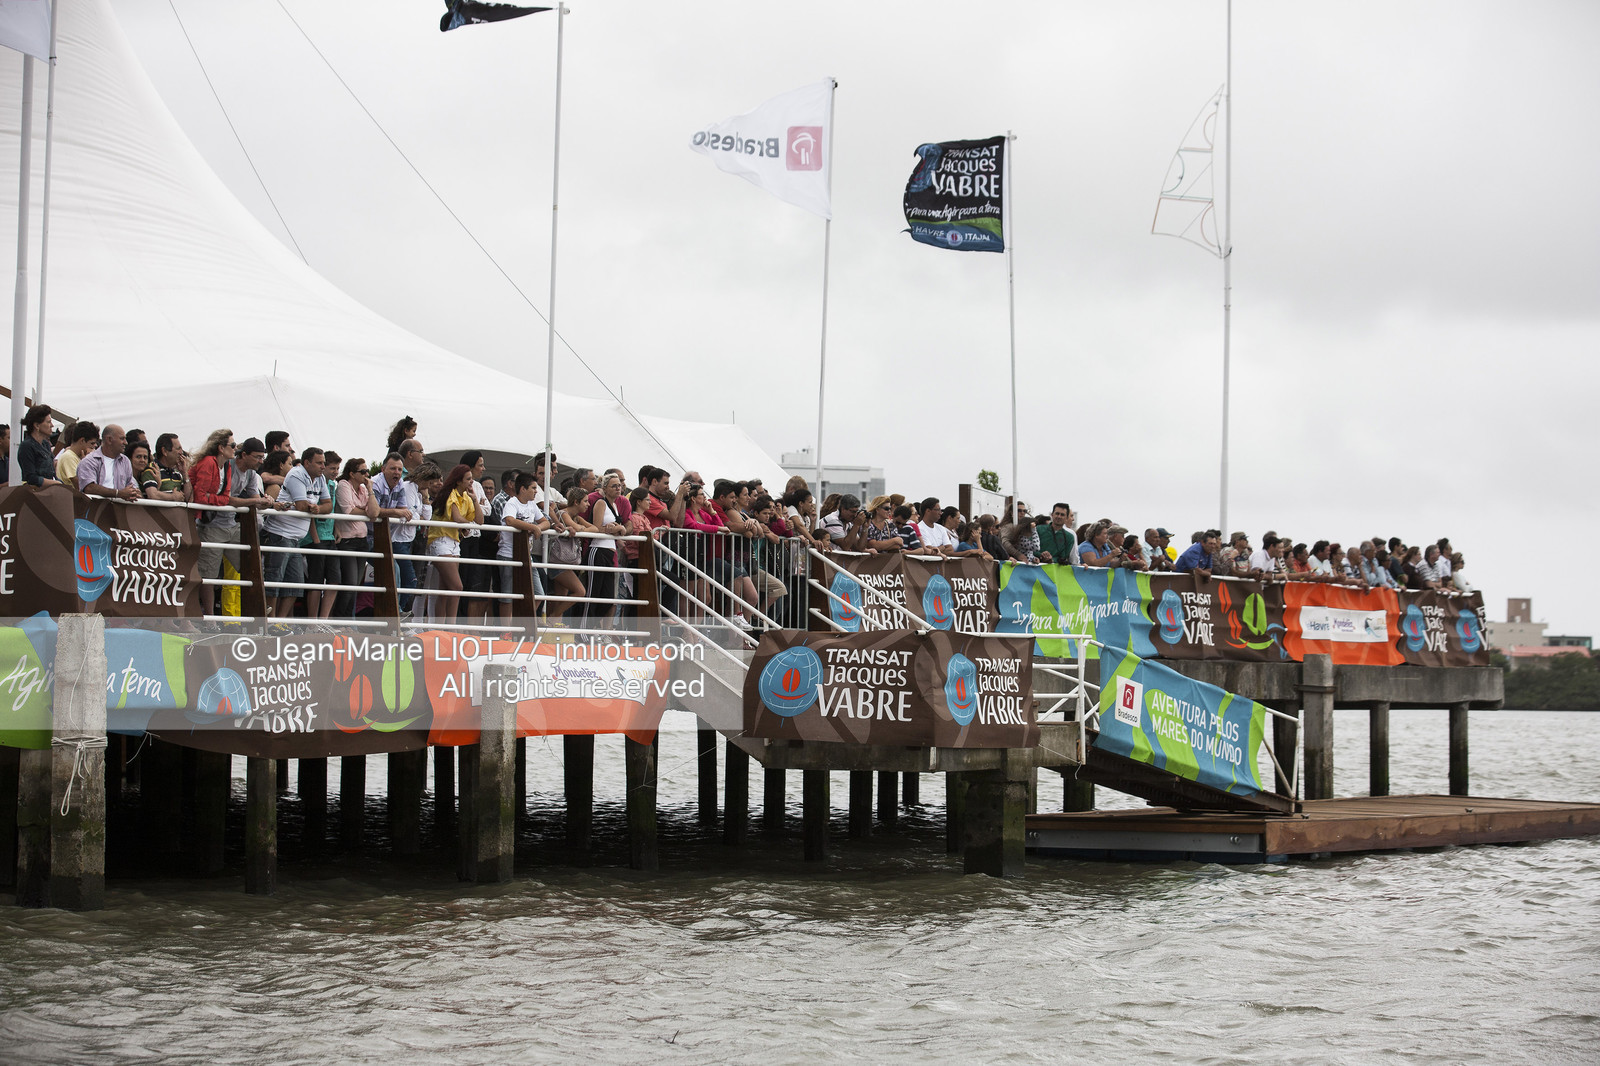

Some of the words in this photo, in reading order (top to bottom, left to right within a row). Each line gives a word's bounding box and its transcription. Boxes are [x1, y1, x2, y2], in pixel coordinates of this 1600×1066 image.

[937, 157, 997, 175] Jacques
[931, 170, 1000, 198] VABRE
[110, 527, 183, 549] TRANSAT
[114, 544, 177, 572] Jacques
[107, 565, 186, 607] VABRE
[951, 577, 988, 591] TRANS
[954, 592, 987, 610] Jacq
[950, 608, 990, 633] VAB
[1026, 612, 1052, 634] para
[1075, 597, 1096, 634] Agir
[1095, 601, 1119, 629] para
[826, 649, 913, 667] TRANSAT
[975, 657, 1022, 673] TRANSAT
[120, 656, 162, 701] terra
[246, 660, 313, 684] TRANSAT
[824, 665, 907, 688] Jacques
[978, 673, 1019, 695] Jacques
[251, 680, 312, 711] Jacques
[815, 684, 913, 722] VABRE
[974, 692, 1028, 725] VABRE
[1117, 708, 1138, 723] Bradesco
[1151, 691, 1206, 729] AVENTURA
[1209, 712, 1240, 742] PELOS
[1152, 713, 1188, 744] MARES
[1190, 728, 1204, 750] DO
[1205, 734, 1242, 766] MUNDO
